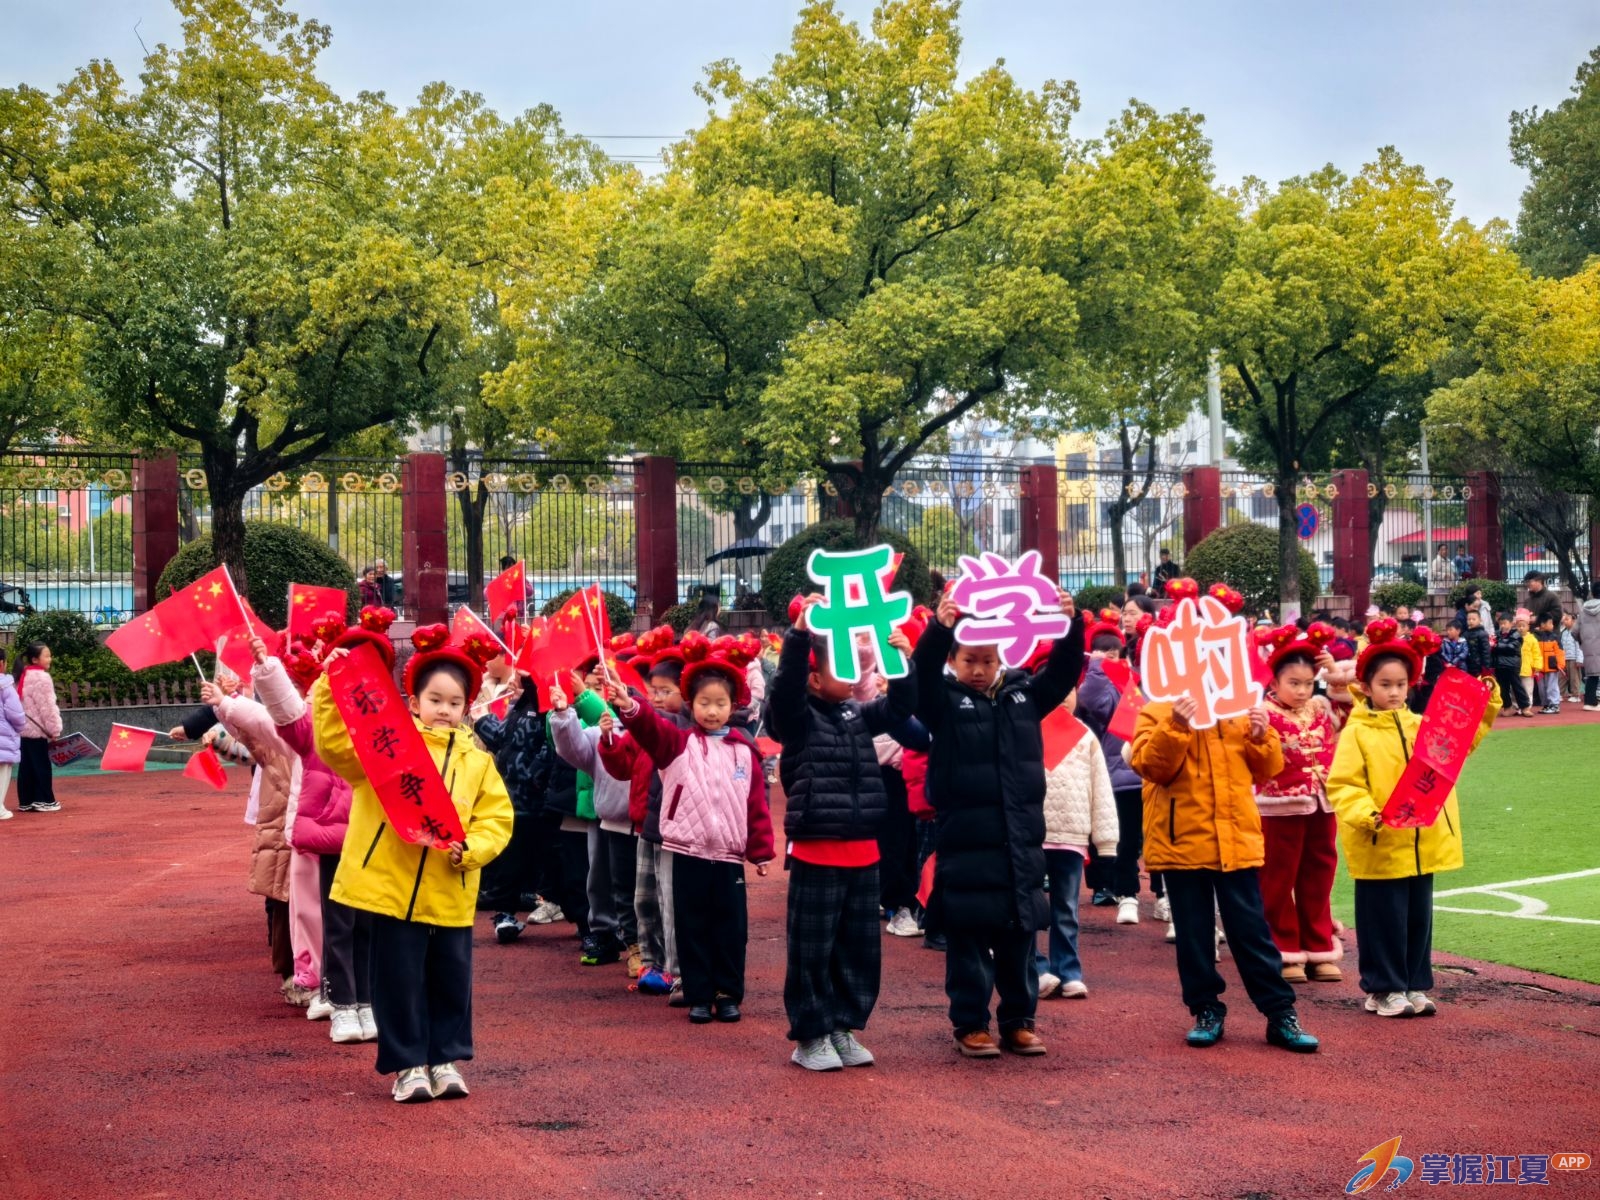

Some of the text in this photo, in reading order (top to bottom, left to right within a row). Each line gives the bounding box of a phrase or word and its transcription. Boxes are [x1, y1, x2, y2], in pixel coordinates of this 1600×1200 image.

[809, 545, 911, 682] 开
[952, 551, 1070, 666] 学
[1143, 597, 1262, 727] 啦
[350, 682, 453, 841] 乐学争先
